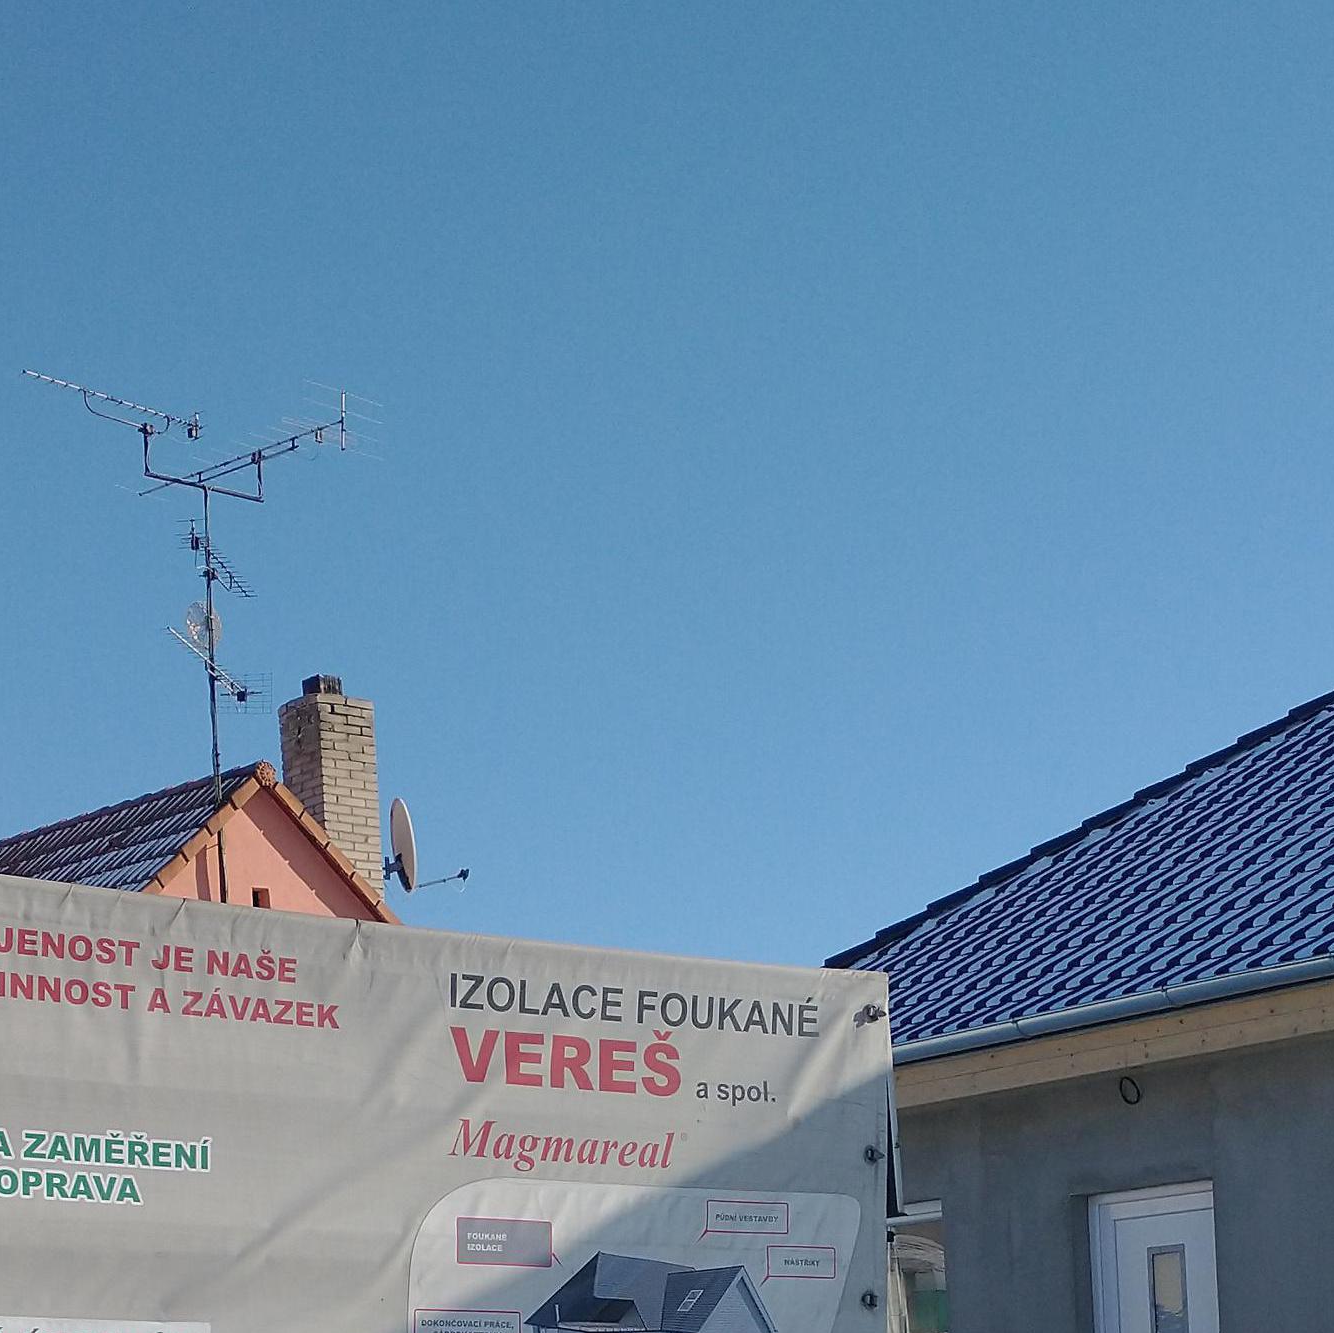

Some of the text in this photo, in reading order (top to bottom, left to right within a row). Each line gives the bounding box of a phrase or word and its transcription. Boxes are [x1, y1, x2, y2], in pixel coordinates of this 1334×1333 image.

[151, 943, 196, 973] JE
[206, 948, 298, 984] NAŠE
[146, 987, 171, 1014] A
[182, 989, 340, 1030] ZÁVAZEK
[449, 972, 820, 1037] IZOLACE FOUKANÉ
[450, 1026, 682, 1097] VEREŠ
[695, 1079, 777, 1106] a spol.
[23, 1130, 212, 1171] ZAMĚŘENÍ
[448, 1117, 675, 1171] Magmareal
[466, 1242, 503, 1252] IZOLACE
